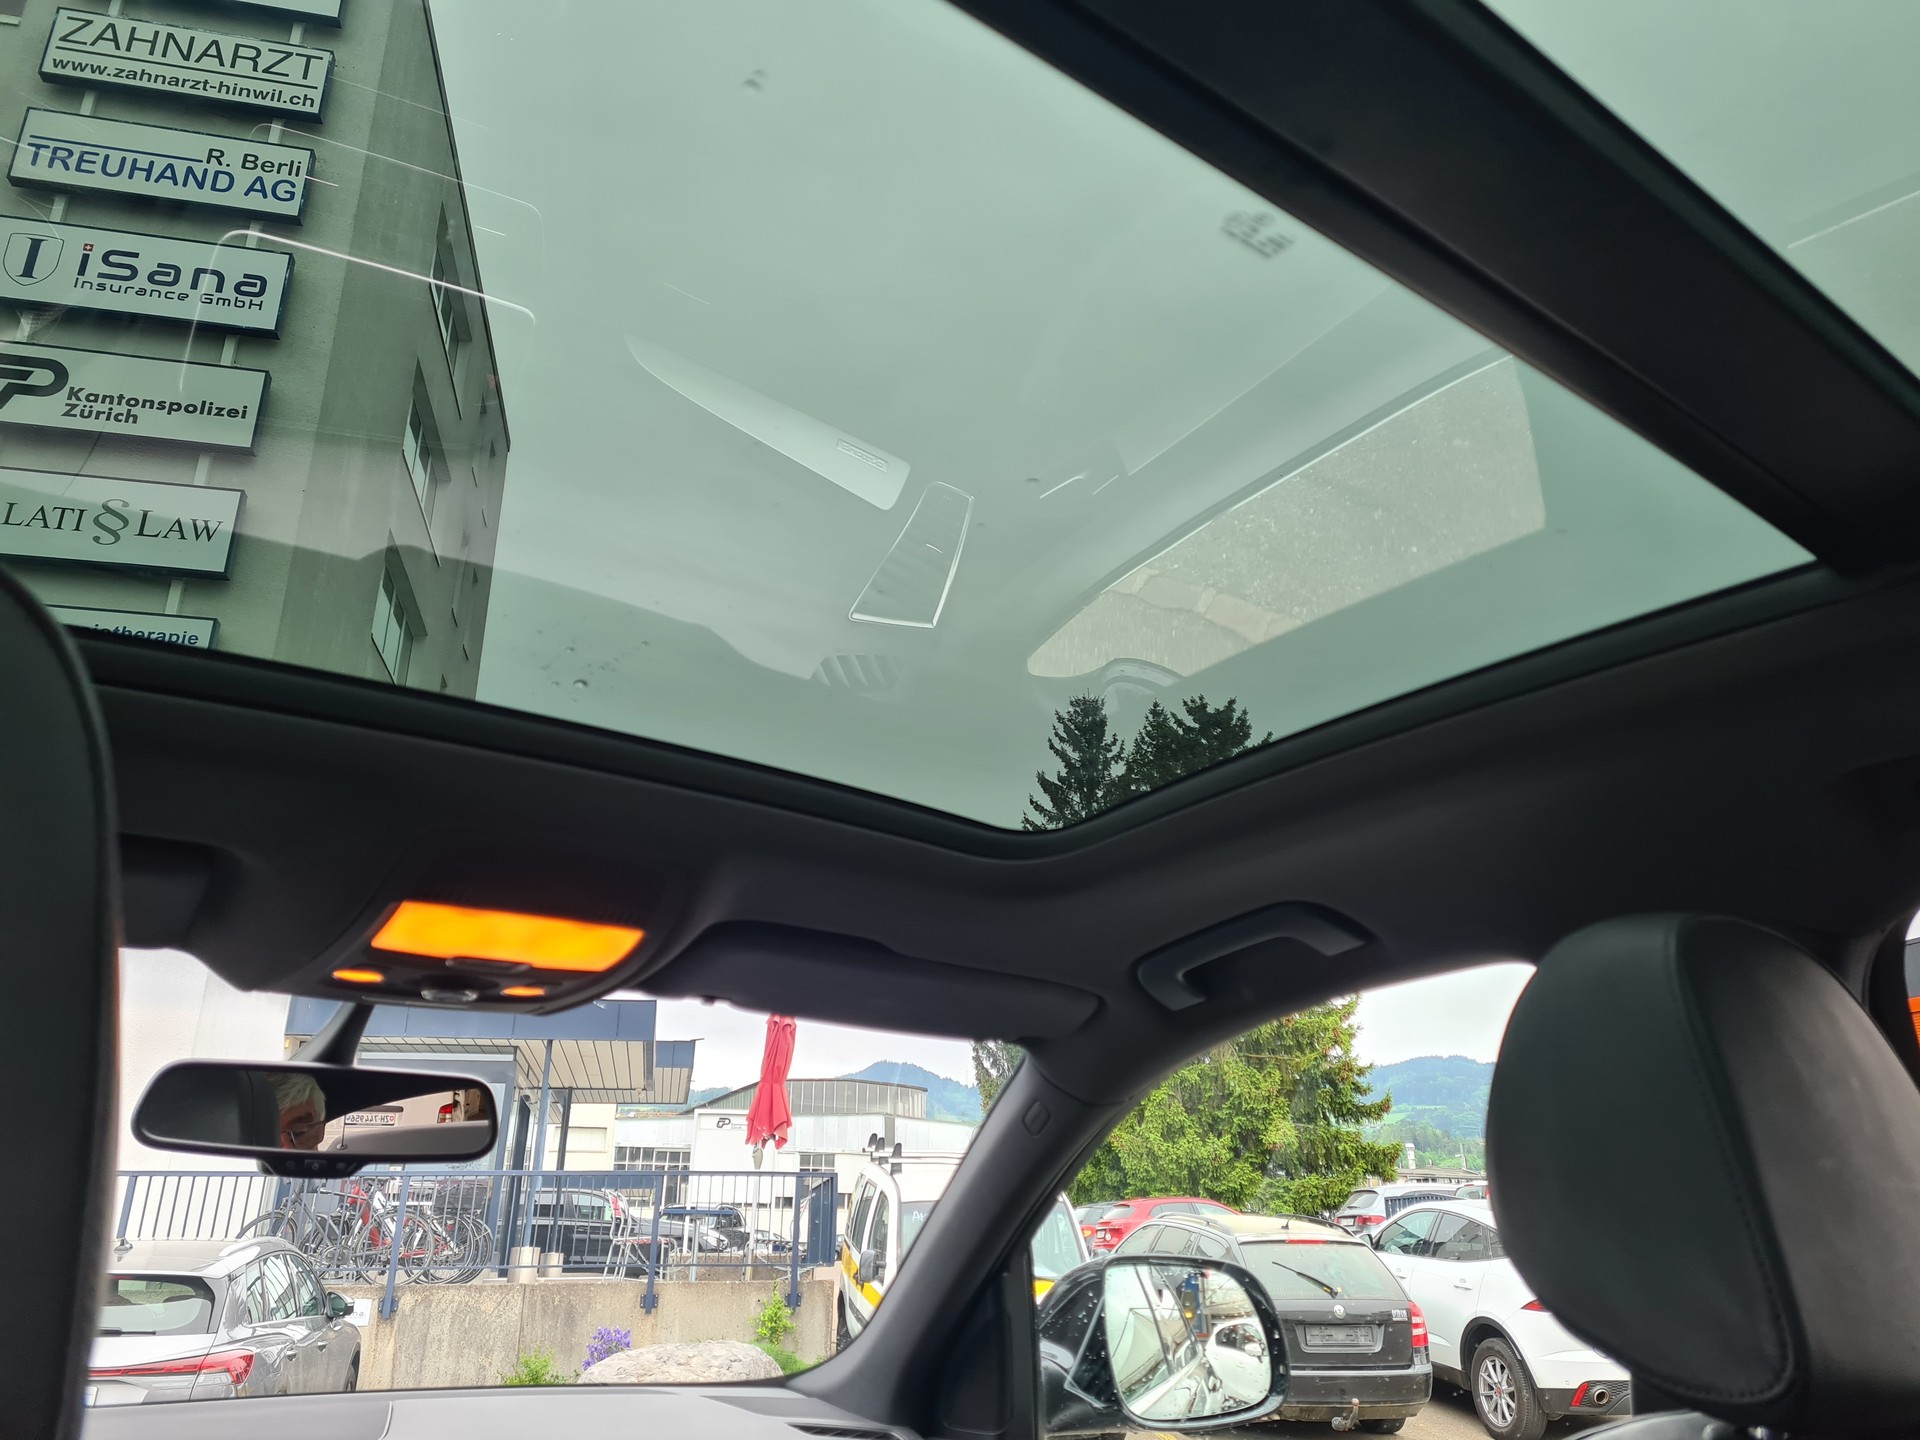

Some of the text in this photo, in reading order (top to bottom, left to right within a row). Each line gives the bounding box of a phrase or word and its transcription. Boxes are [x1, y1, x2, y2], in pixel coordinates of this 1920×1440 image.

[58, 15, 324, 81] ZAHNARZT
[52, 56, 315, 109] www.zahnarzt-hinwil.ch
[27, 142, 297, 202] TREUHAND AG
[205, 147, 302, 178] R. Berli
[76, 243, 268, 298] iSana
[73, 276, 264, 311] Insurance GmbH
[60, 401, 139, 425] Zürich
[66, 386, 248, 420] Kantonspolizei
[133, 508, 225, 543] LAW
